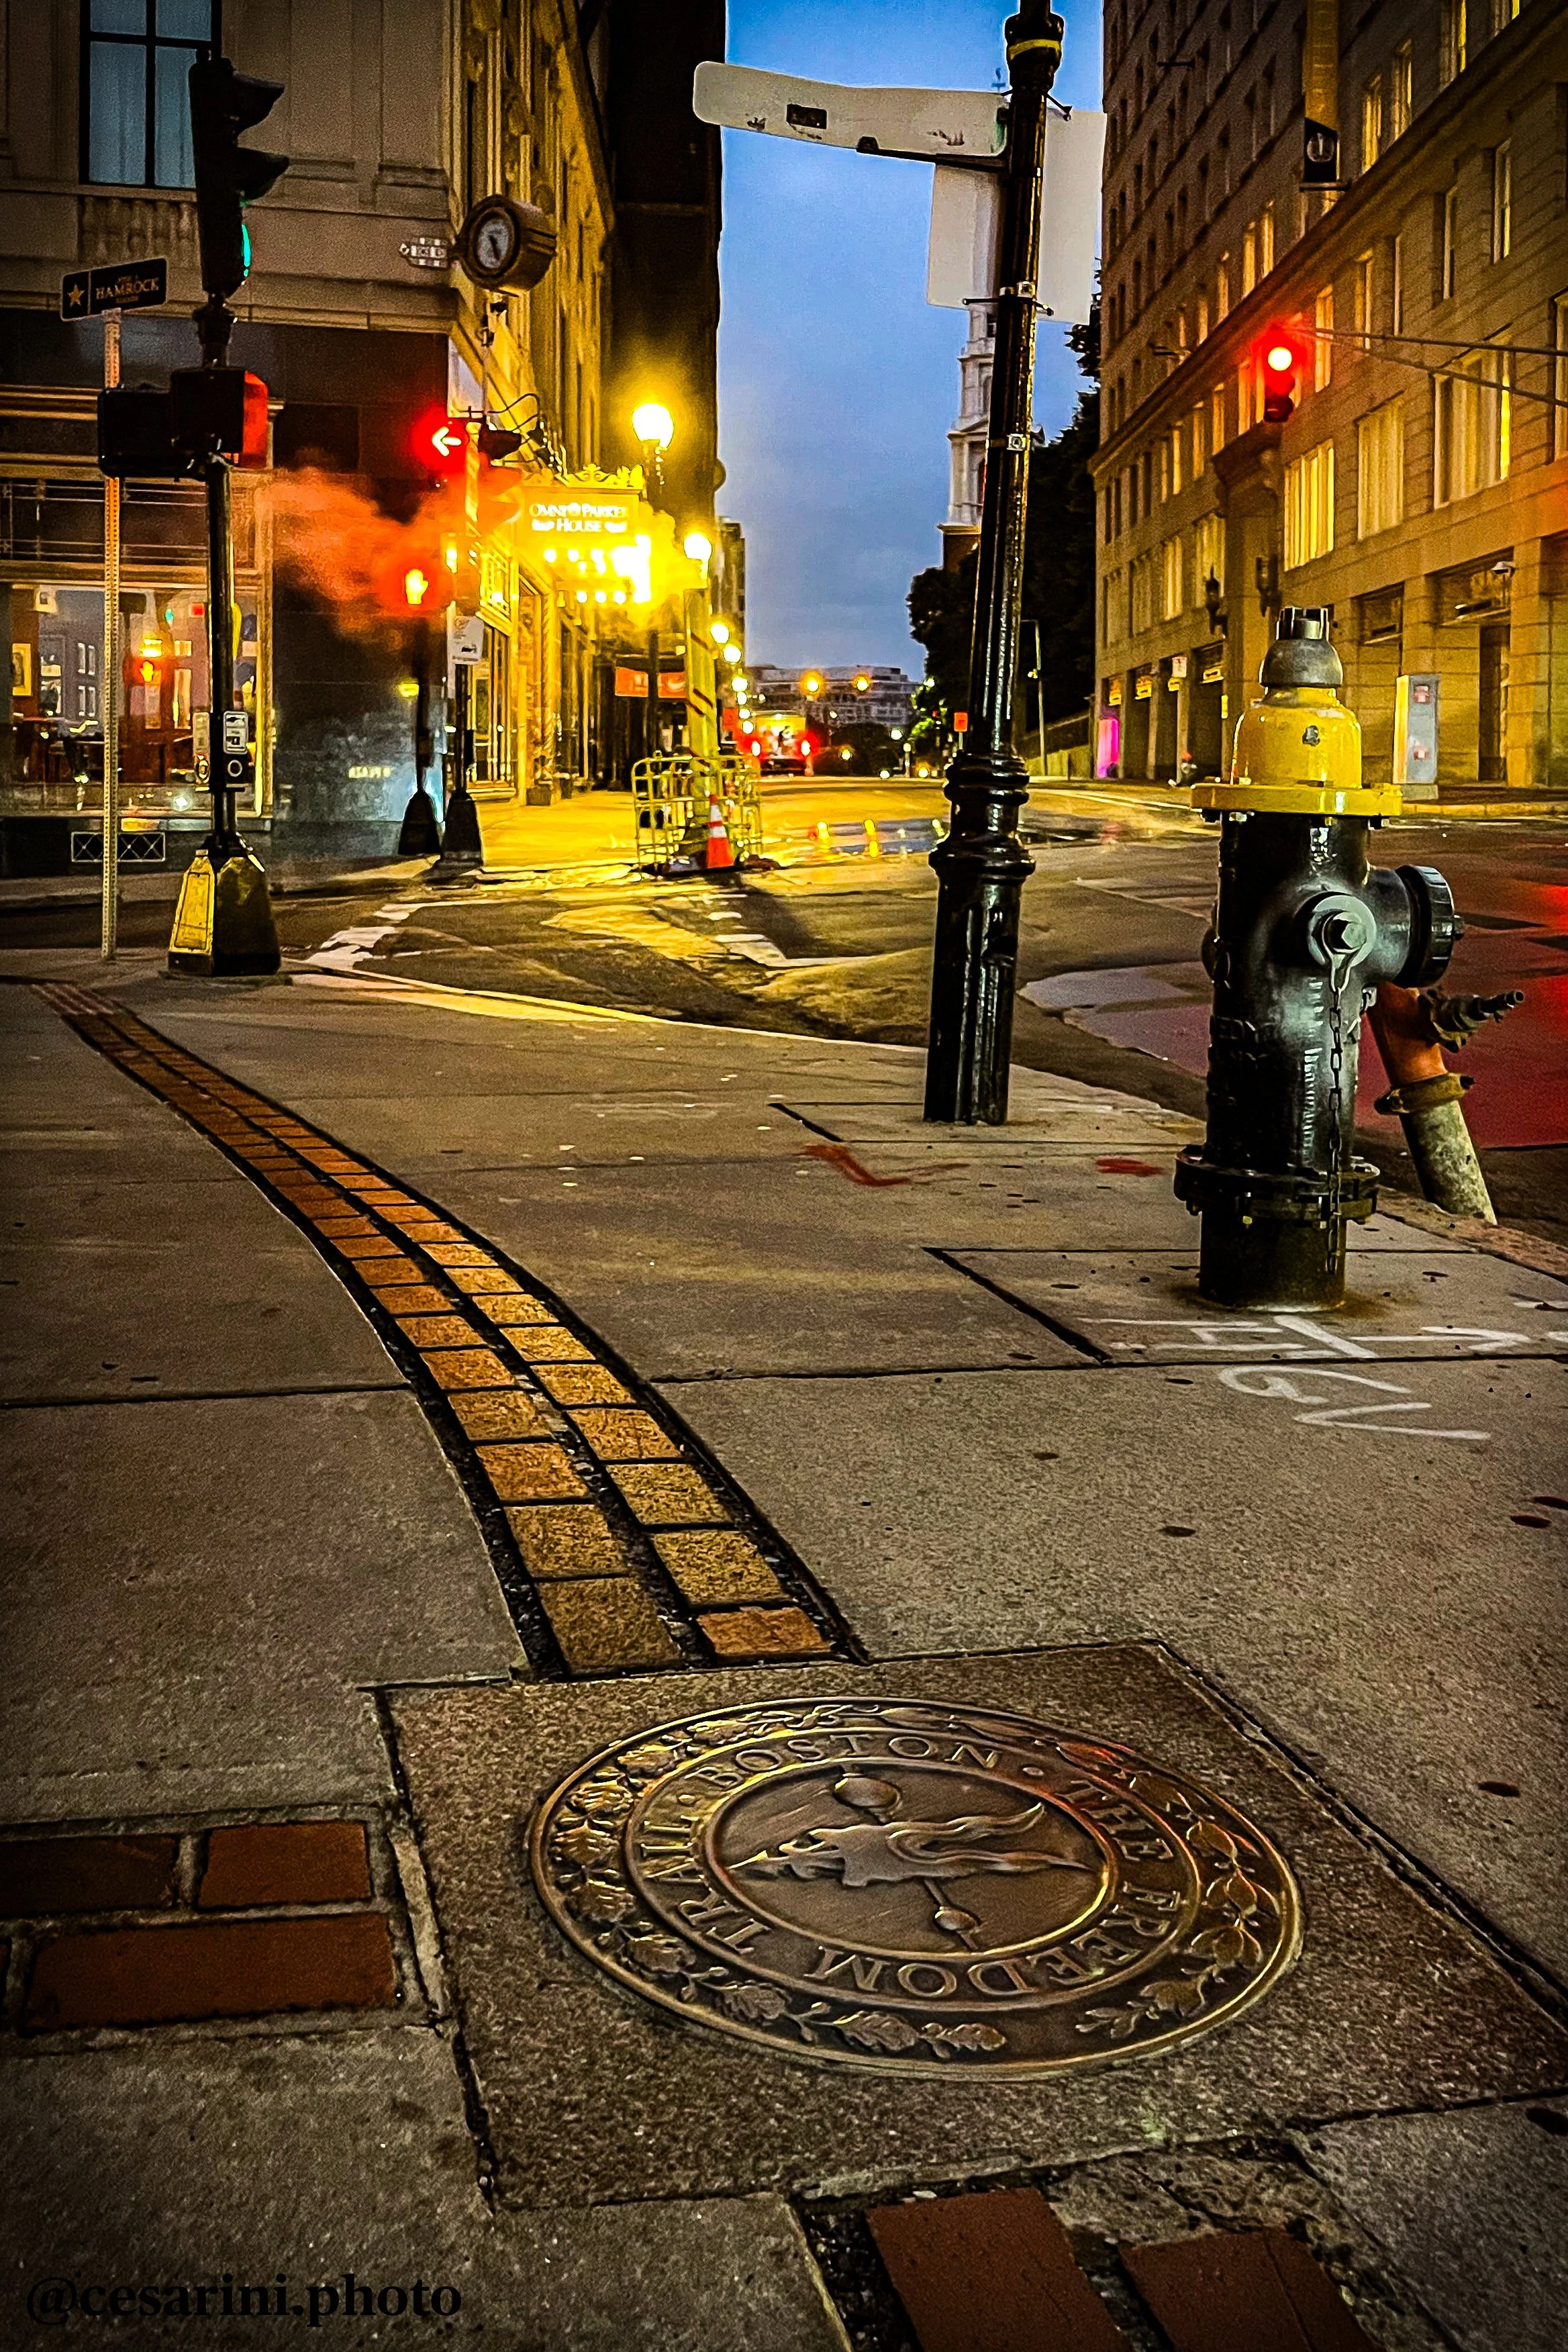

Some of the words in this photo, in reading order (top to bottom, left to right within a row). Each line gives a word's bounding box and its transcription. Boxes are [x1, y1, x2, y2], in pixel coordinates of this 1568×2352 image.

[556, 518, 603, 532] HOUSE
[684, 1733, 1003, 1788] BOSTON
[1056, 1779, 1175, 1861] THE
[640, 1814, 773, 1955] TRAIL
[803, 1881, 1181, 1998] FREEDOM
